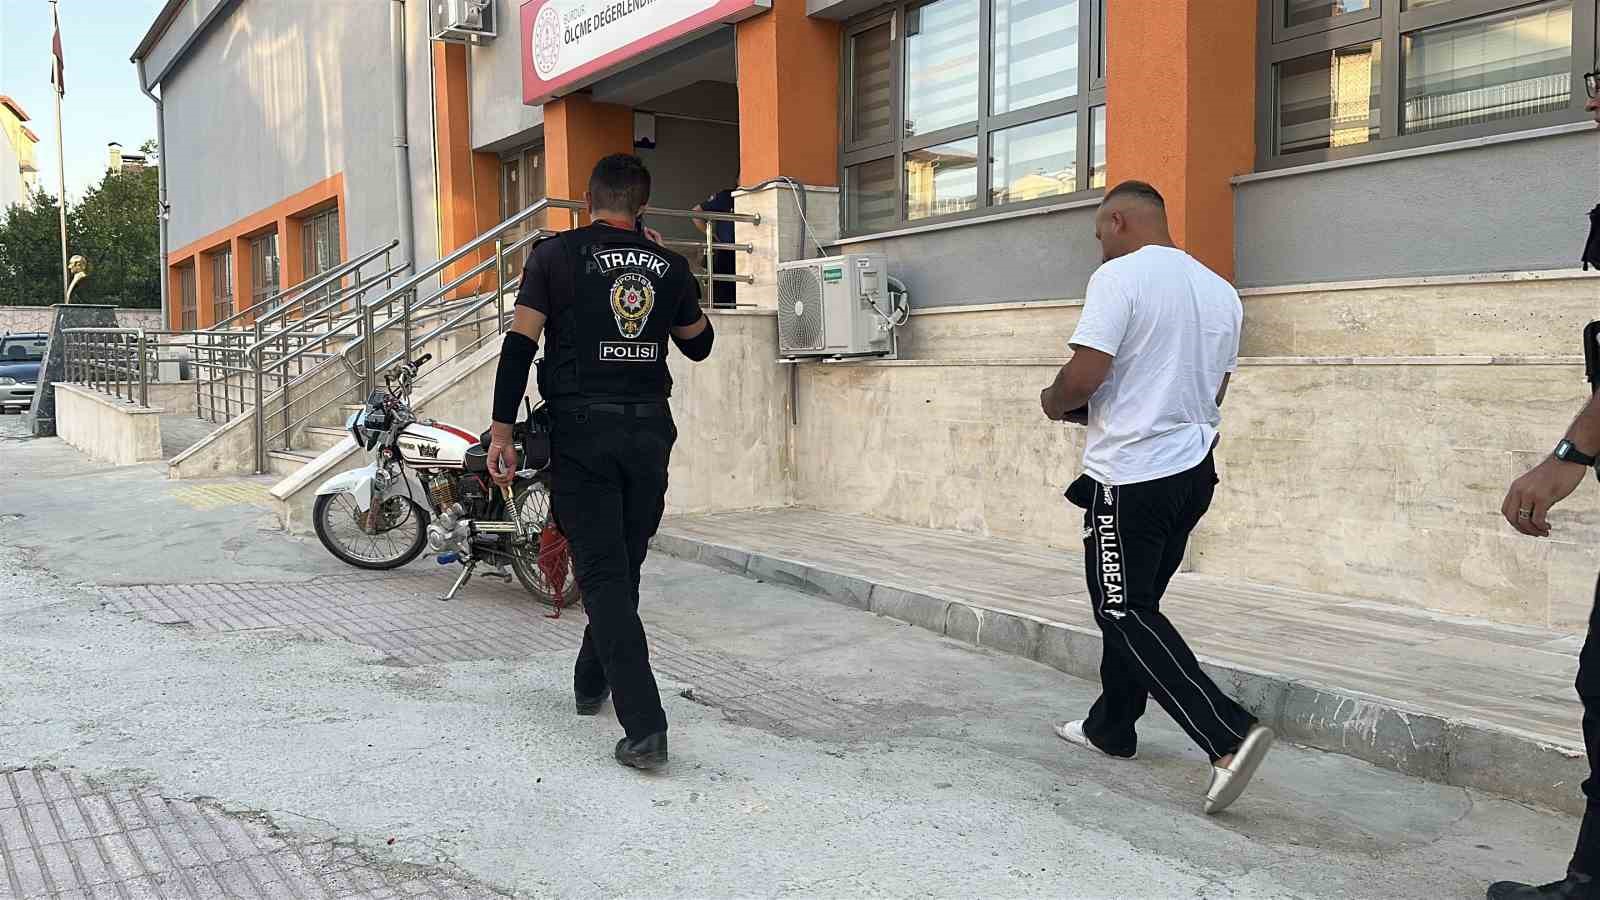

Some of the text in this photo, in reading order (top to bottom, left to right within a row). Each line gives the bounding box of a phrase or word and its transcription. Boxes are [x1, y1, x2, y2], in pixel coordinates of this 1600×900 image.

[564, 0, 657, 45] ÖLÇME DEĞERLEND
[603, 345, 655, 358] POLİSİ
[1097, 515, 1123, 605] PULL&BEAR
